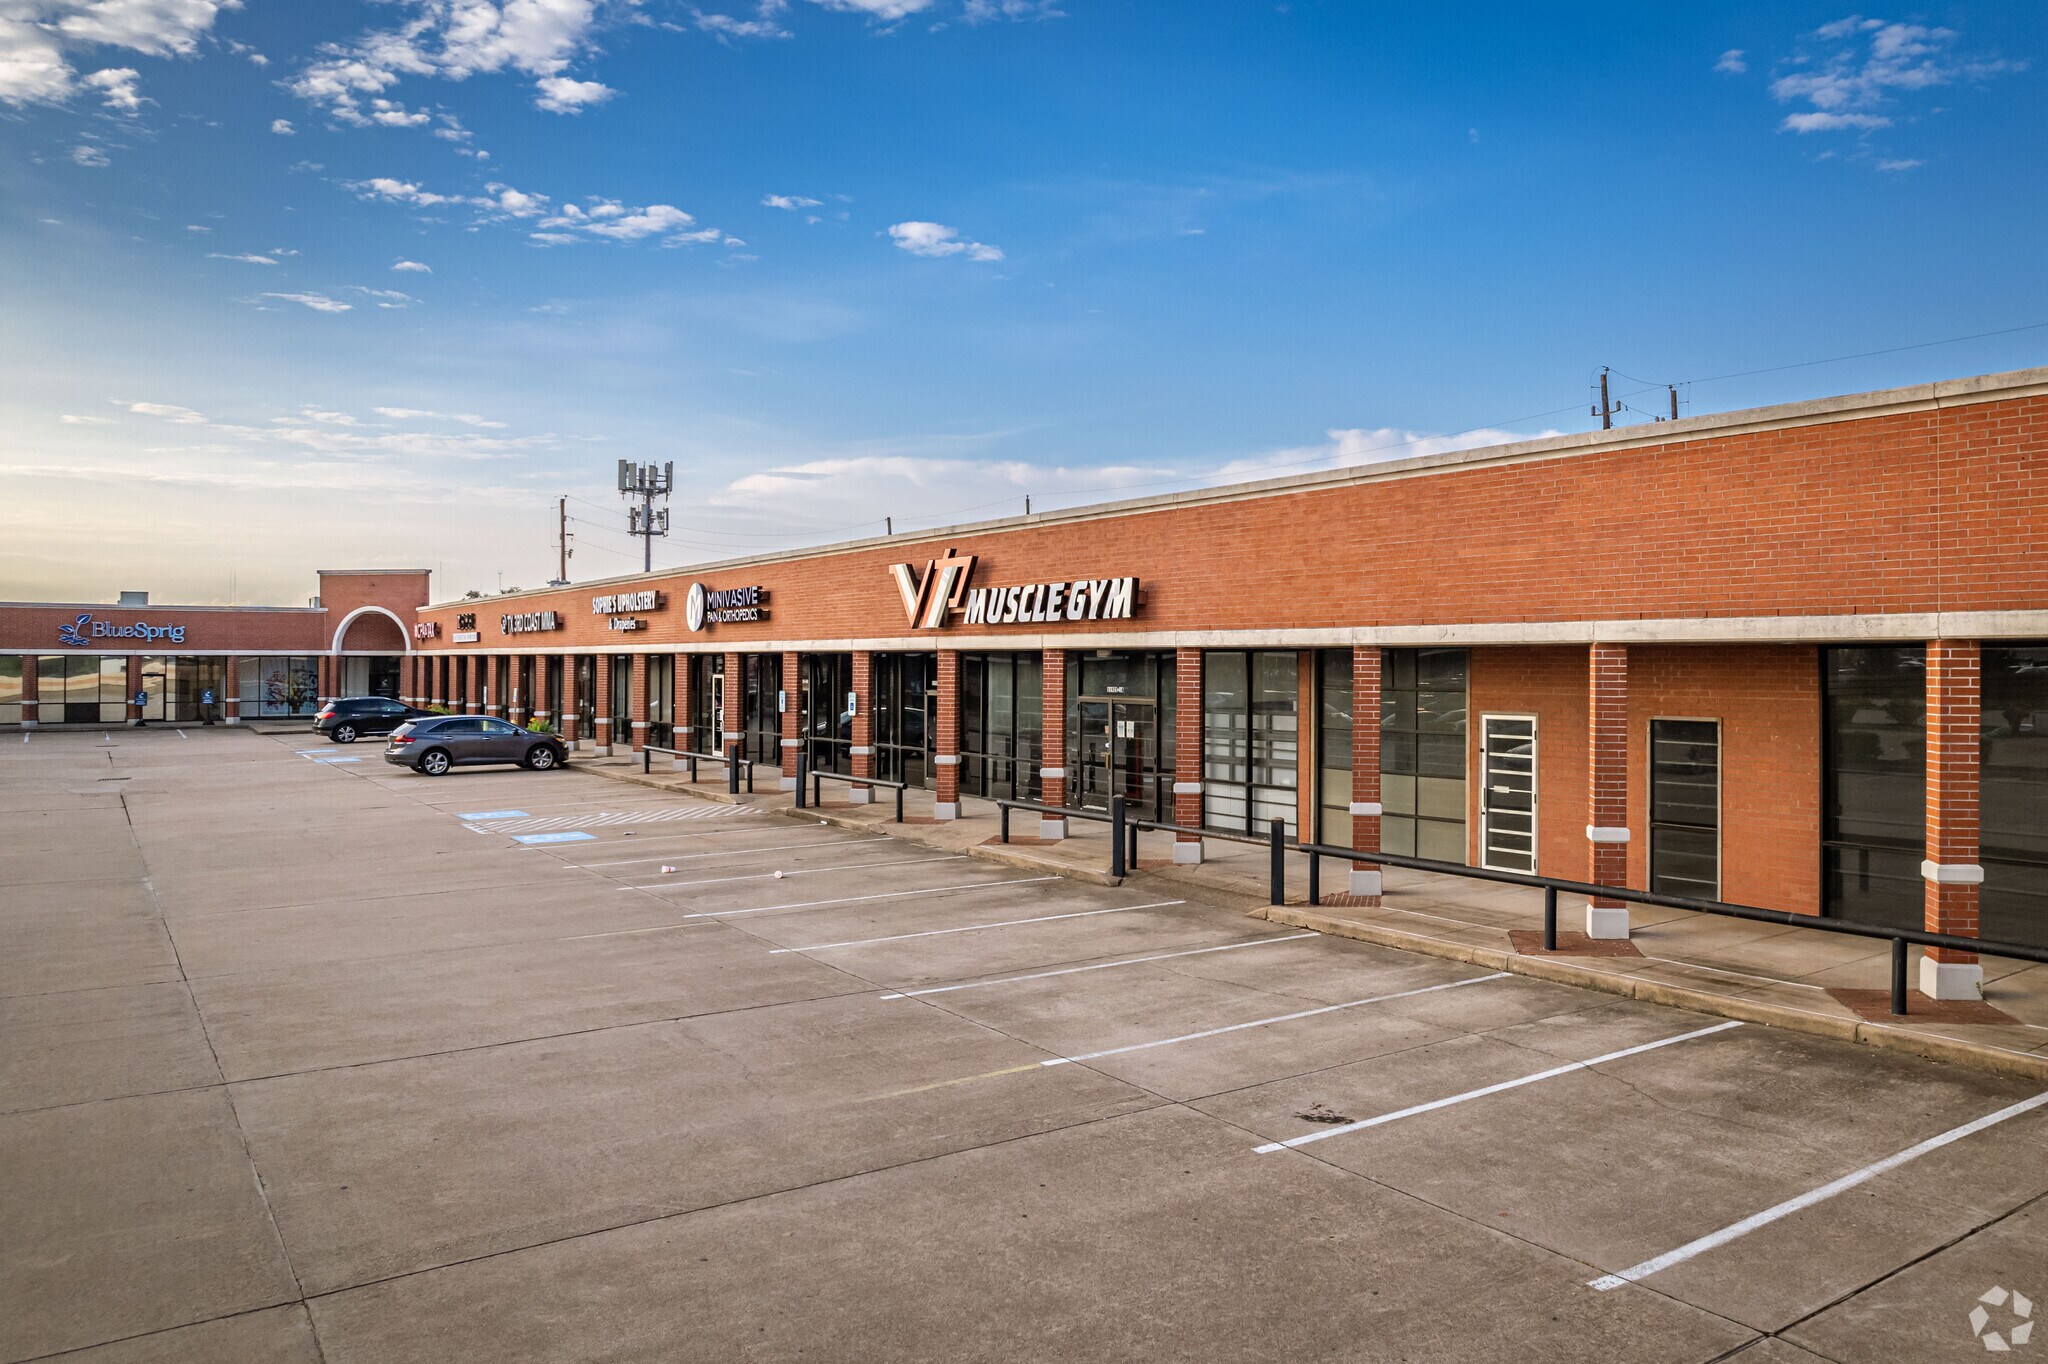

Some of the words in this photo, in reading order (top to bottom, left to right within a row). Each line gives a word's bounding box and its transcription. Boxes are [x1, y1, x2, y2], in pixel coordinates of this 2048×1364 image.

[592, 595, 617, 615] SOPHIE'S
[617, 590, 656, 613] UPHOLSTERY
[707, 586, 758, 609] MINIVASIVE
[963, 584, 1066, 625] MUSCLE
[1066, 577, 1133, 620] GYM
[523, 612, 540, 632] COAST
[613, 616, 636, 633] Draperies
[707, 611, 718, 623] PAIN
[723, 608, 758, 622] ORTHOPEDICS
[91, 621, 185, 643] BlueSprig
